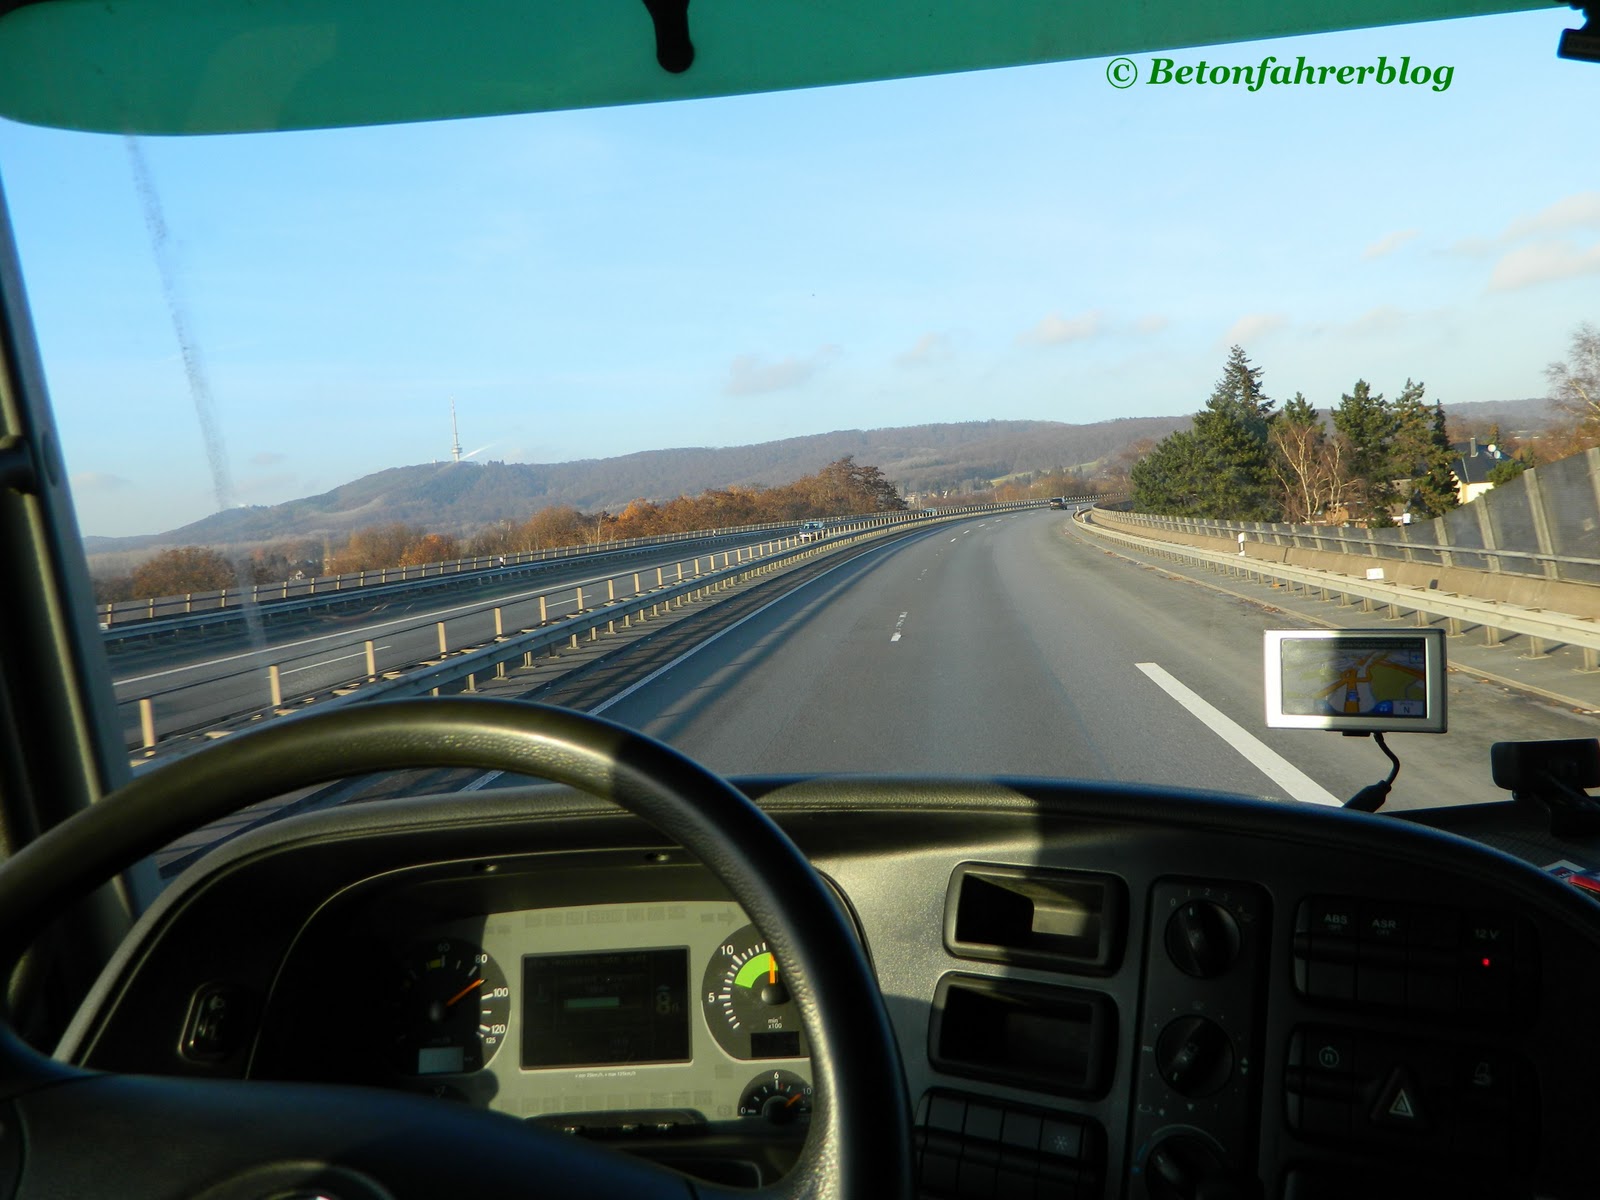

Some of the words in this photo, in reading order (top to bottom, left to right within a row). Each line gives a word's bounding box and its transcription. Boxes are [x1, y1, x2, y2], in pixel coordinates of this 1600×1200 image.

[1324, 913, 1348, 925] ABS
[1371, 918, 1396, 929] ASR
[437, 943, 451, 952] 60
[721, 944, 734, 956] 10
[475, 954, 488, 964] 80
[493, 988, 509, 997] 100
[708, 992, 715, 1003] 5
[491, 1024, 506, 1034] 120
[773, 1071, 780, 1079] 6
[803, 1087, 812, 1095] 10
[740, 1106, 746, 1114] 0
